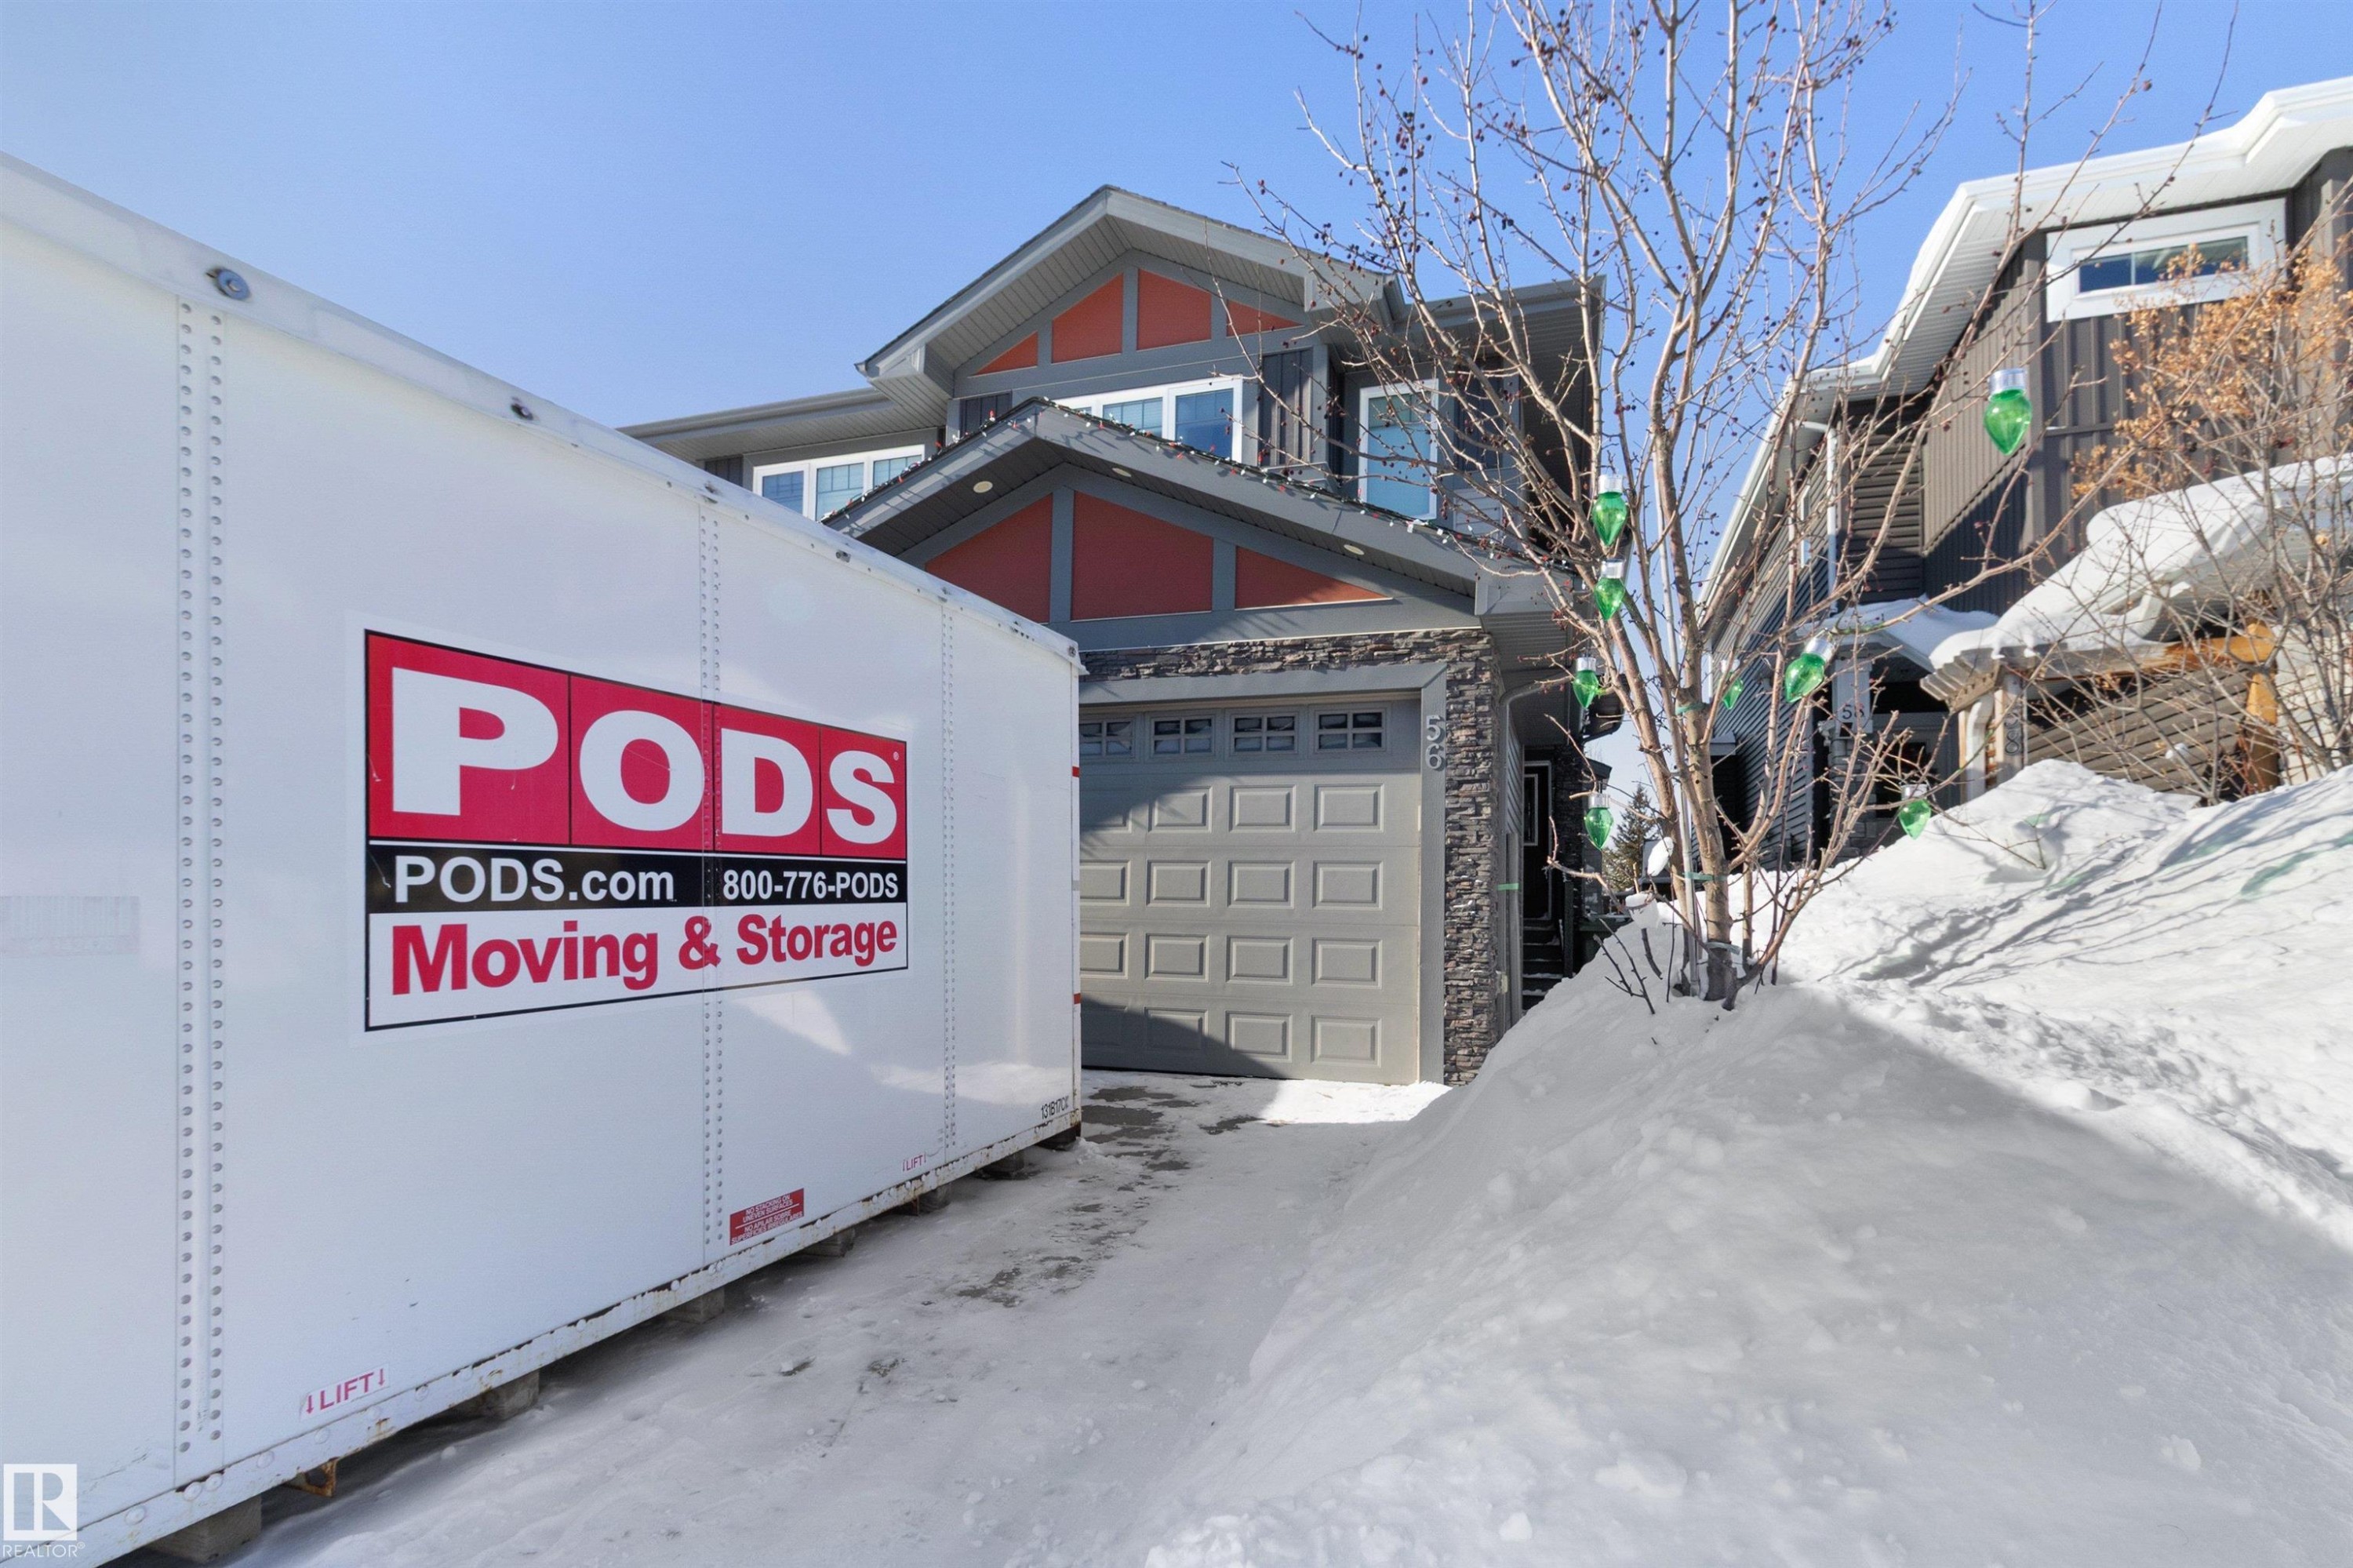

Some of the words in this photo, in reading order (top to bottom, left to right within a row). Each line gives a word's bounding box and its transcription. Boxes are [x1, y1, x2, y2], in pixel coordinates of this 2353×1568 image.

[392, 666, 897, 845] PODS
[1425, 715, 1442, 769] 56
[395, 855, 675, 903] PODS.com
[722, 869, 898, 900] 800-776-PODS
[393, 920, 658, 995] Moving
[678, 915, 721, 970] &
[736, 914, 897, 967] Storage
[906, 1155, 923, 1171] LIFT
[743, 1210, 765, 1223] UNEVEN
[766, 1199, 793, 1214] SURFACES
[755, 1198, 781, 1212] STACKING
[744, 1224, 753, 1233] NO
[320, 1372, 374, 1410] LIFT
